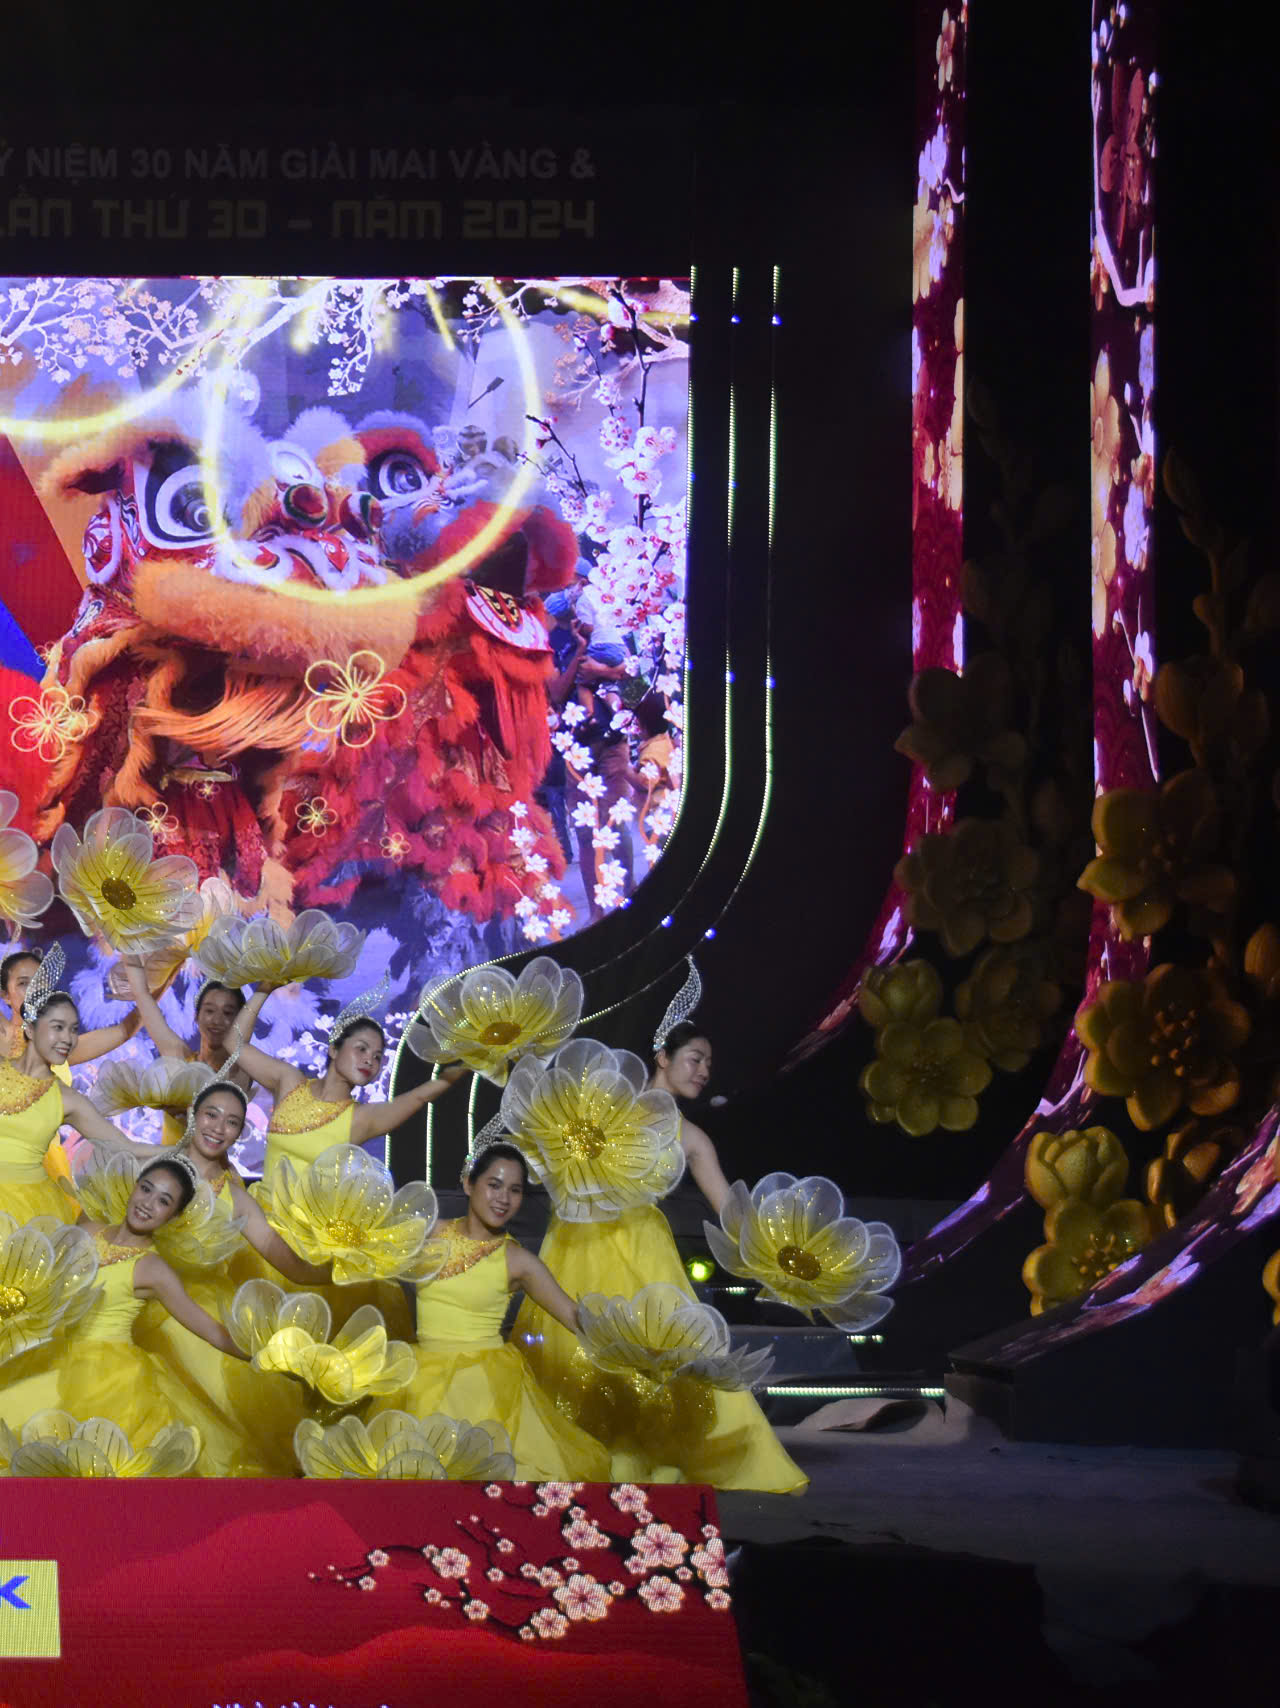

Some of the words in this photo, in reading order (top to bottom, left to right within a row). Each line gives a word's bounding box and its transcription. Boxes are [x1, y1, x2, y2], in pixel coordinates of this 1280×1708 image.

[25, 142, 119, 186] NIỆM
[129, 148, 173, 179] 30
[183, 143, 269, 180] NĂM
[279, 143, 357, 181] GIẢI
[369, 148, 437, 179] MAI
[451, 141, 558, 179] VÀNG
[569, 148, 595, 179] &
[207, 199, 267, 238] 30
[462, 199, 595, 240] 2024
